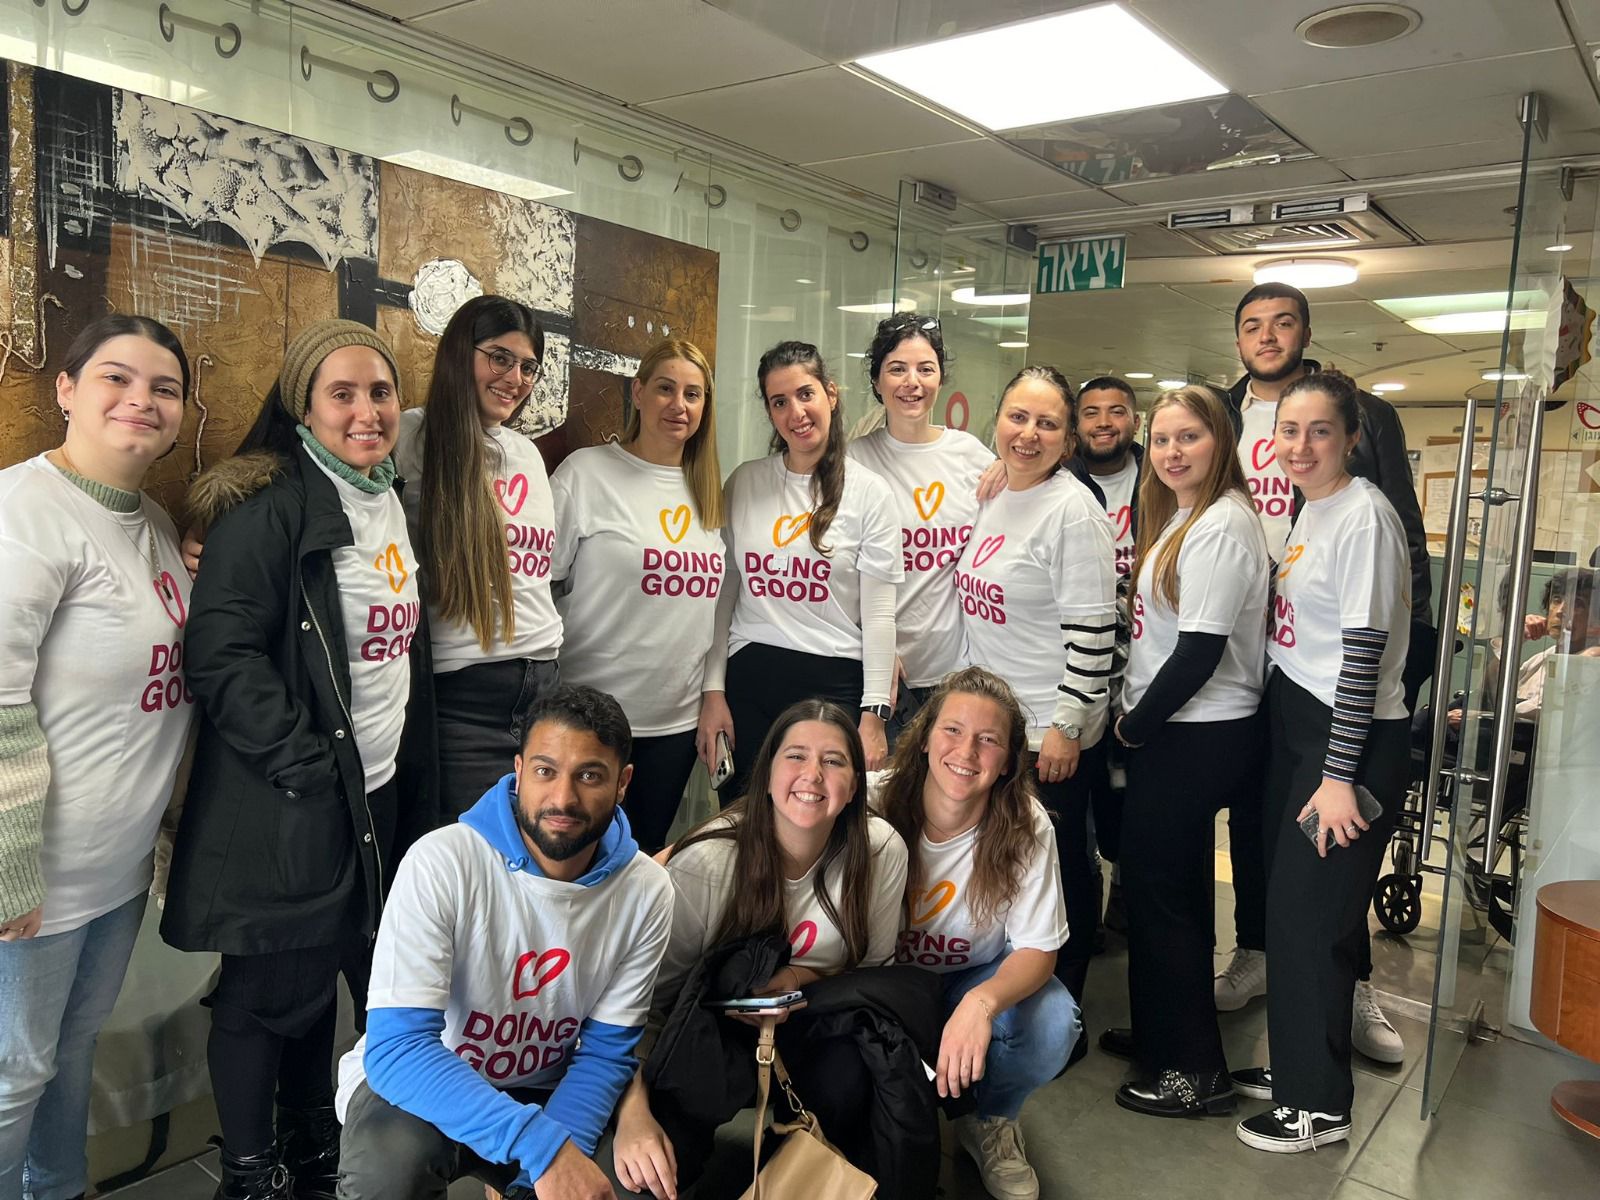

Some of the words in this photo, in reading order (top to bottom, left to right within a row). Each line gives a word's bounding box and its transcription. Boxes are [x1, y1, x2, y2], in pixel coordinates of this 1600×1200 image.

[1040, 239, 1121, 293] יציאה
[1247, 476, 1291, 497] OIN
[504, 523, 555, 553] OING
[507, 550, 551, 578] OOD
[643, 548, 723, 574] DOING
[641, 573, 720, 598] GOOD
[748, 576, 829, 602] GOOD
[366, 600, 419, 633] DOIN
[958, 591, 1007, 625] OOD
[360, 631, 414, 662] GOO
[141, 676, 194, 712] GO
[462, 1010, 579, 1048] DOING
[455, 1043, 565, 1080] GOOD
